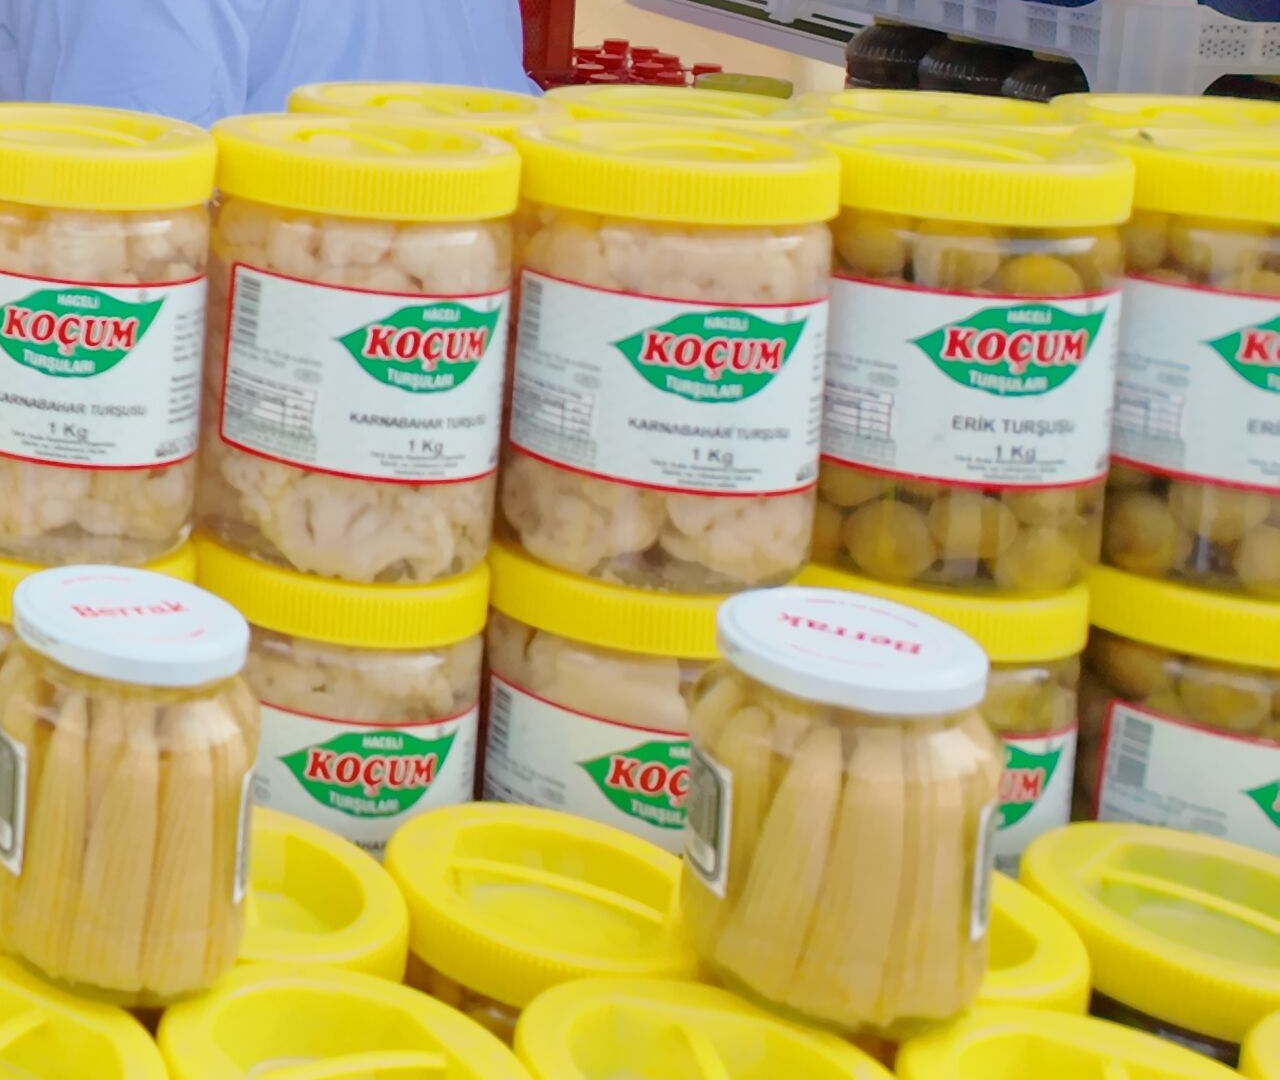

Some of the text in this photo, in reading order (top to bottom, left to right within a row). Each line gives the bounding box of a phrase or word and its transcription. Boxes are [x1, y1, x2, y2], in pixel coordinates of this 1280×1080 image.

[2, 306, 138, 355] KOÇUM
[365, 325, 488, 370] KOÇUM
[642, 330, 786, 379] KOÇUM
[941, 326, 1089, 375] KOÇUM
[23, 348, 96, 375] TURŞULARI
[387, 367, 455, 391] TURŞULARI
[666, 374, 744, 400] TURŞULARI
[968, 369, 1048, 395] TURŞULARI
[48, 421, 89, 441] 1 Kg
[349, 411, 443, 430] KARNABAHAR
[627, 417, 734, 440] KARNABAHAR
[951, 414, 1076, 437] ERİK TURŞUSU
[407, 439, 444, 458] 1 Kg
[691, 448, 734, 466] 1 Kg
[69, 599, 190, 619] Berrak
[777, 611, 924, 655] Berrak
[306, 748, 438, 796] KOÇUM
[608, 755, 689, 807] KOÇ
[329, 791, 400, 815] TURŞULARI
